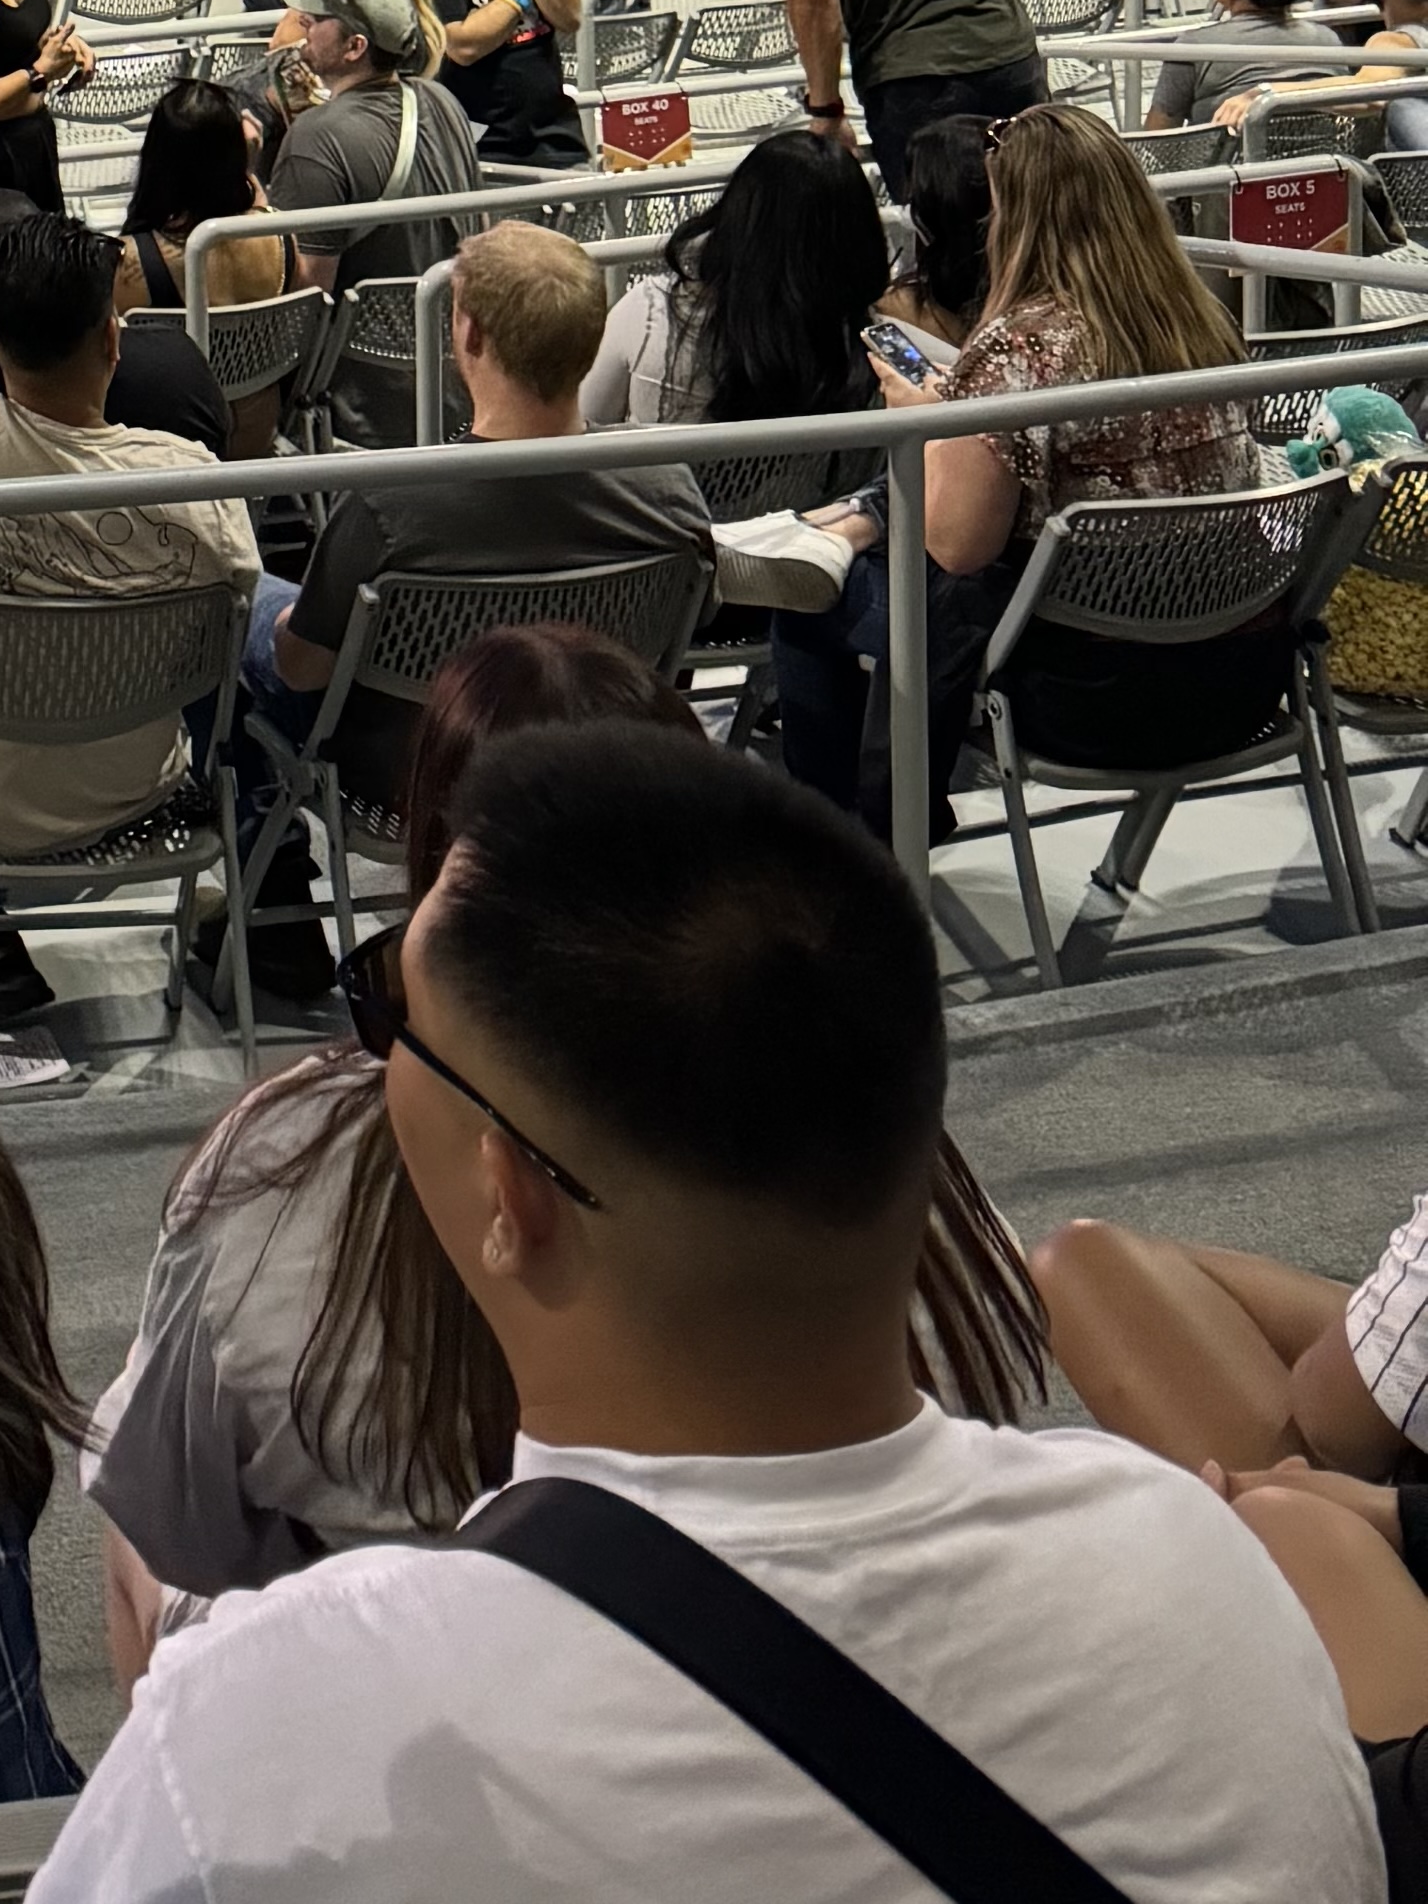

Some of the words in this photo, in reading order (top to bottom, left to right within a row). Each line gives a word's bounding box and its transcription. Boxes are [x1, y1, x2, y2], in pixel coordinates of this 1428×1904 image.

[622, 102, 649, 116] BOX
[652, 99, 669, 111] 40
[1265, 181, 1301, 200] BOX
[1305, 179, 1316, 195] 5
[1274, 202, 1306, 215] SEATS
